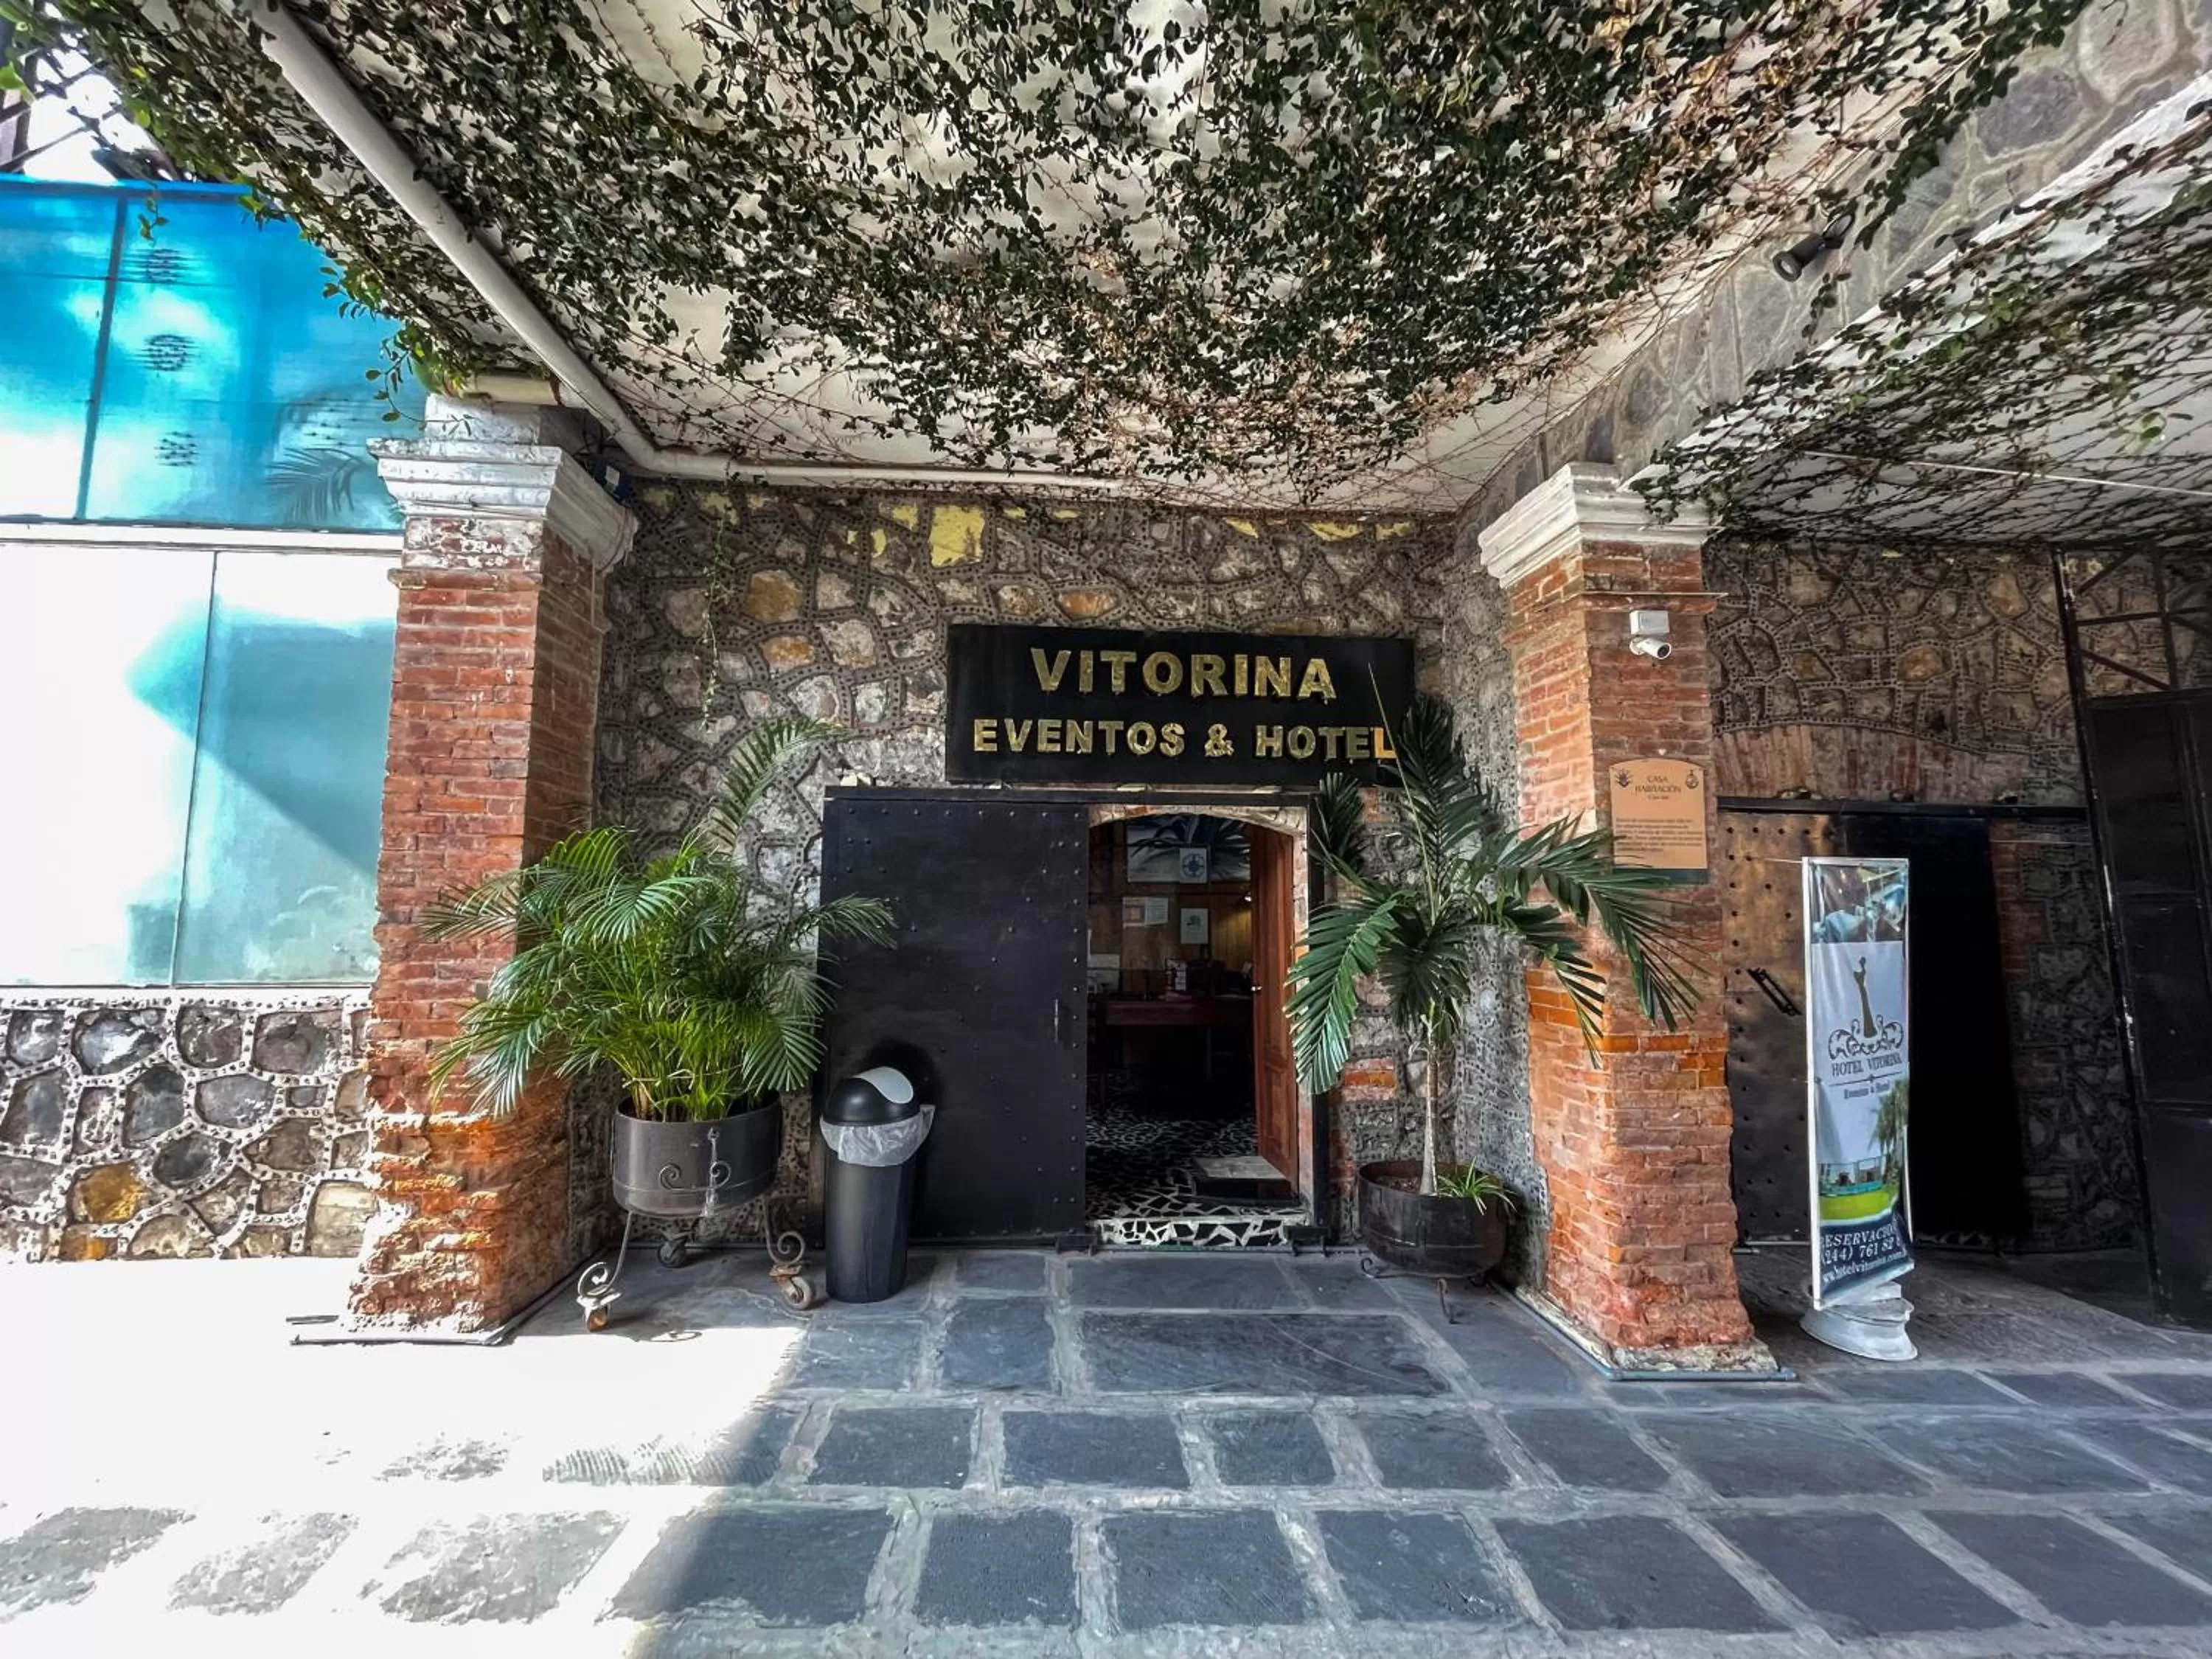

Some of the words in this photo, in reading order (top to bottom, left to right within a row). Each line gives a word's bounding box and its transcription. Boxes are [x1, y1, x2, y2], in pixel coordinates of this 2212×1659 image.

[1029, 647, 1337, 700] VITORINA
[973, 719, 1187, 757] EVENTOS
[1204, 723, 1235, 757] &
[1256, 725, 1398, 760] HOTEL
[1832, 1060, 1864, 1077] HOTEL
